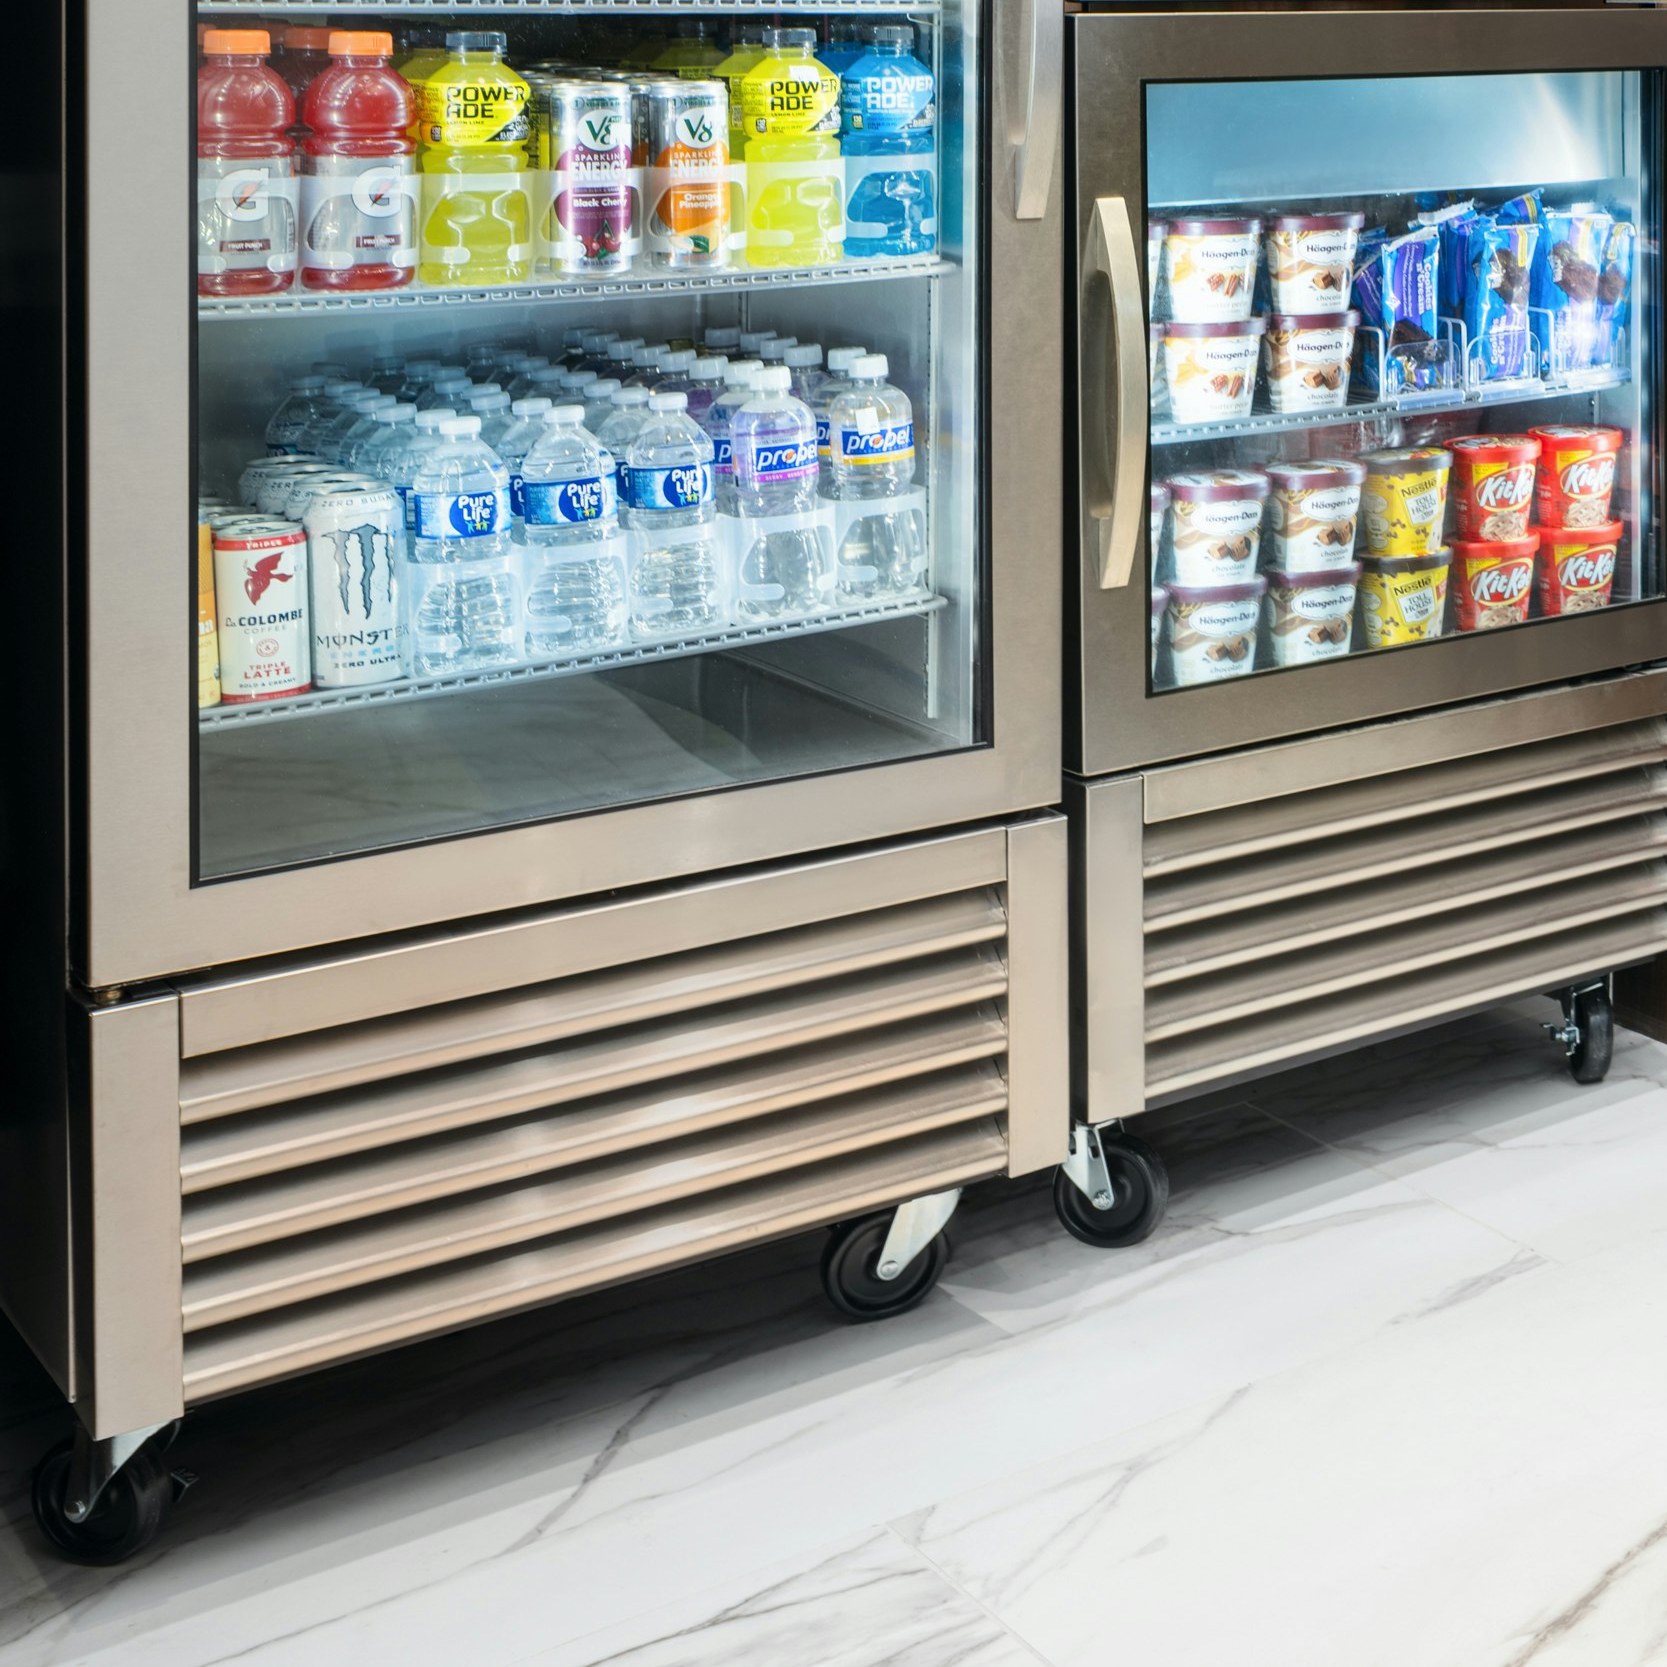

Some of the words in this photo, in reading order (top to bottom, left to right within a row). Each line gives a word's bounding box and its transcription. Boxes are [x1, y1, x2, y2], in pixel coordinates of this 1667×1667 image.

[770, 78, 838, 96] POWER
[866, 75, 934, 94] POWER
[446, 85, 526, 102] POWER
[866, 92, 910, 109] ADE
[446, 103, 495, 119] ADE
[770, 95, 814, 111] ADE
[683, 115, 714, 143] V8
[570, 159, 629, 181] ENERGY
[572, 197, 600, 207] Black
[1423, 262, 1434, 311] Cookies
[846, 424, 911, 454] propel
[756, 438, 818, 471] propel
[671, 469, 703, 486] Pure
[675, 477, 701, 494] Life
[567, 482, 602, 500] Pure
[1415, 492, 1434, 505] TOLL
[321, 499, 354, 508] ZERO
[457, 493, 495, 512] Pure
[571, 493, 599, 509] Life
[462, 504, 493, 522] Life
[245, 539, 283, 550] TRIPLE
[1404, 598, 1432, 616] HOUSE
[1407, 592, 1427, 606] TOLL
[238, 608, 304, 627] COLOMBE
[243, 624, 288, 635] COFFEE
[243, 667, 292, 680] LATTE
[249, 661, 286, 670] TRIPLE
